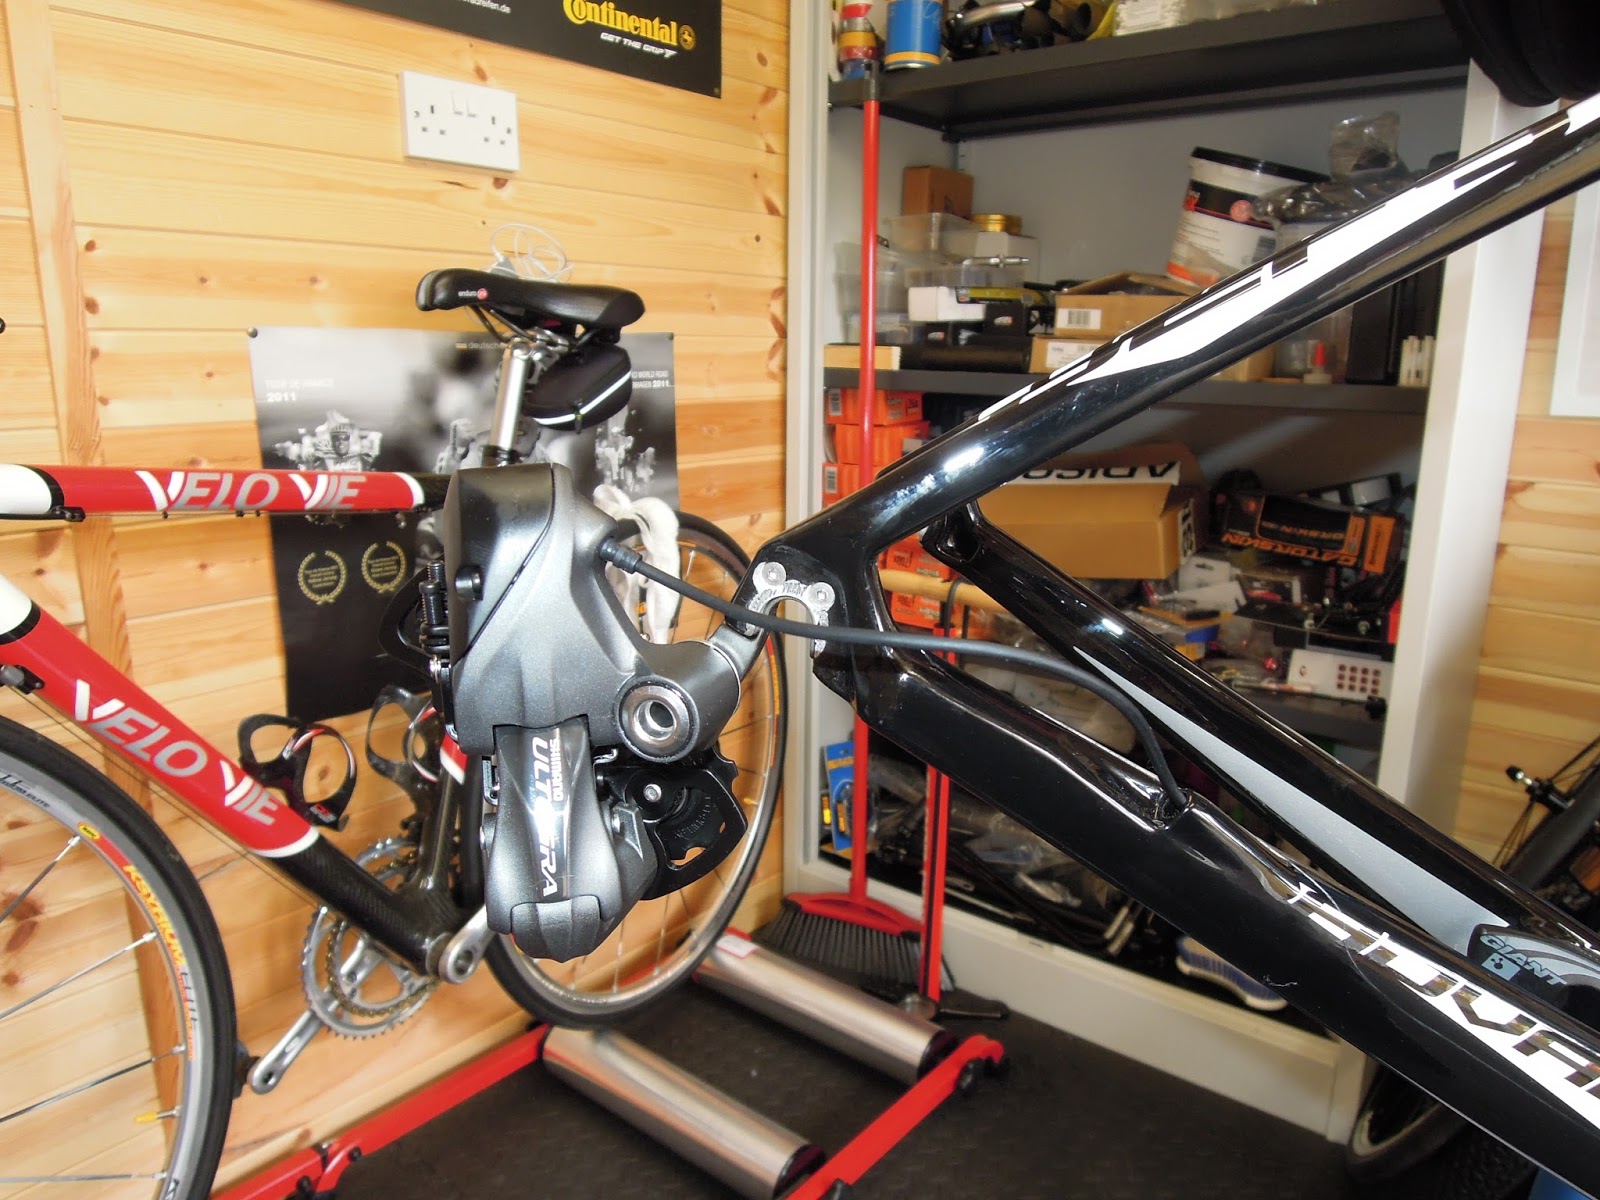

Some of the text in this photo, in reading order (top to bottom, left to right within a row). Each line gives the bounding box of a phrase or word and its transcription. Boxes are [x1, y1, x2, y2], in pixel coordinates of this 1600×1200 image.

[563, 0, 679, 46] Continental
[600, 32, 622, 43] GET
[623, 37, 642, 49] THE
[265, 391, 297, 403] 2011
[652, 379, 669, 388] 2011
[135, 470, 367, 511] VELO VIE
[1221, 532, 1358, 567] GATORSKIN
[73, 679, 279, 826] VELO VIE
[548, 738, 564, 802] SHIMANO
[1478, 932, 1568, 987] GIANT
